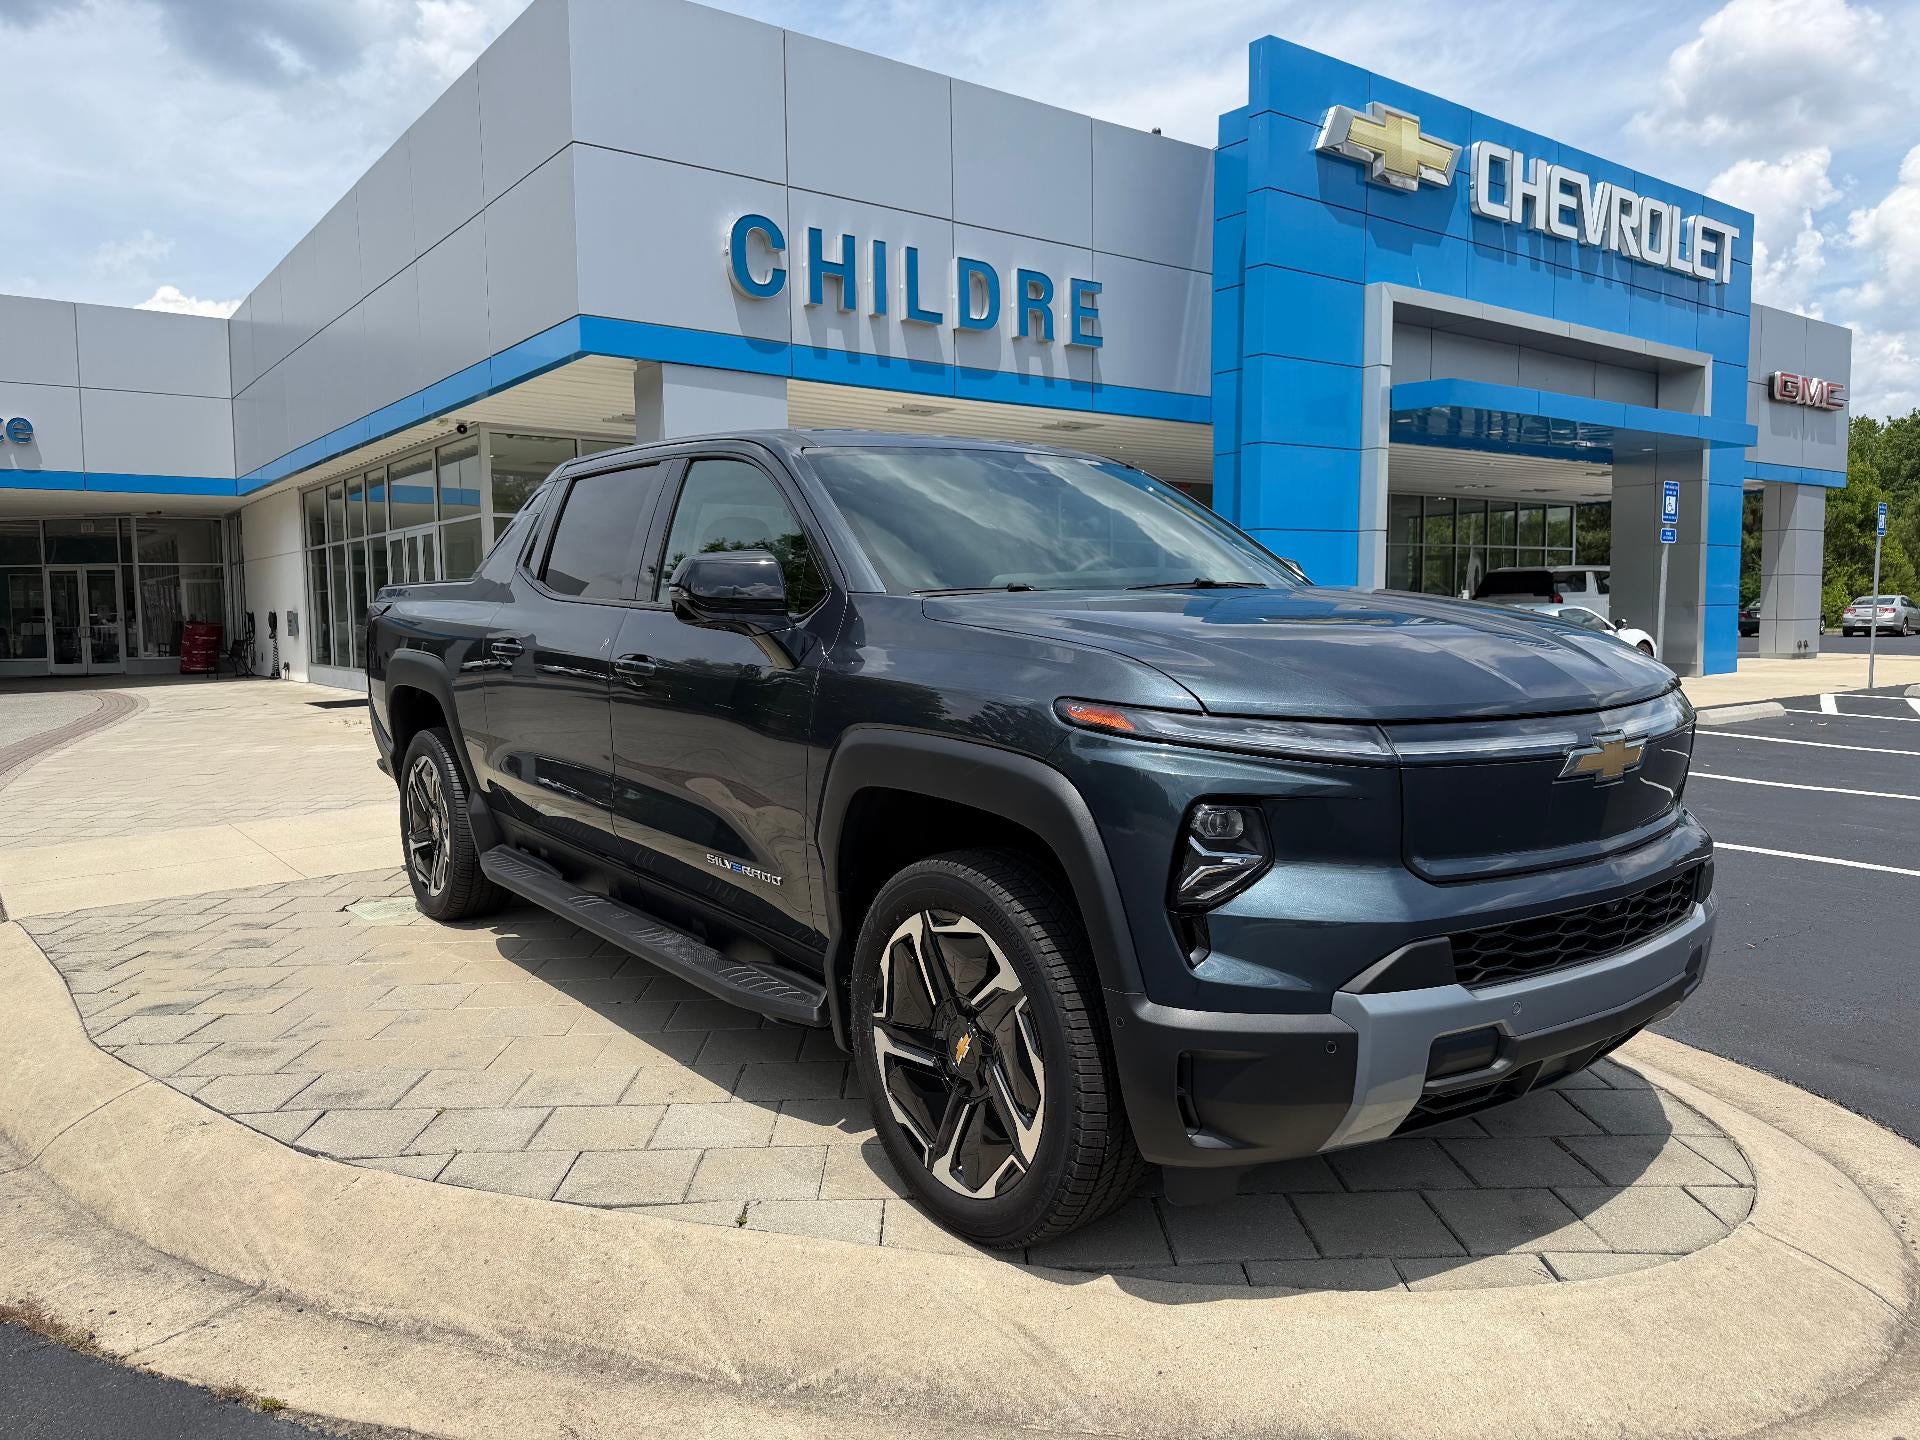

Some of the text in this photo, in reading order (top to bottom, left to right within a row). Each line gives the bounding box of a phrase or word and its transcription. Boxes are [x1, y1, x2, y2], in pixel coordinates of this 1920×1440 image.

[1470, 140, 1740, 284] CHEVROLET
[727, 213, 1103, 348] CHILDRE
[1769, 371, 1845, 410] GMC
[0, 417, 33, 443] e
[706, 853, 783, 886] SILVERADO
